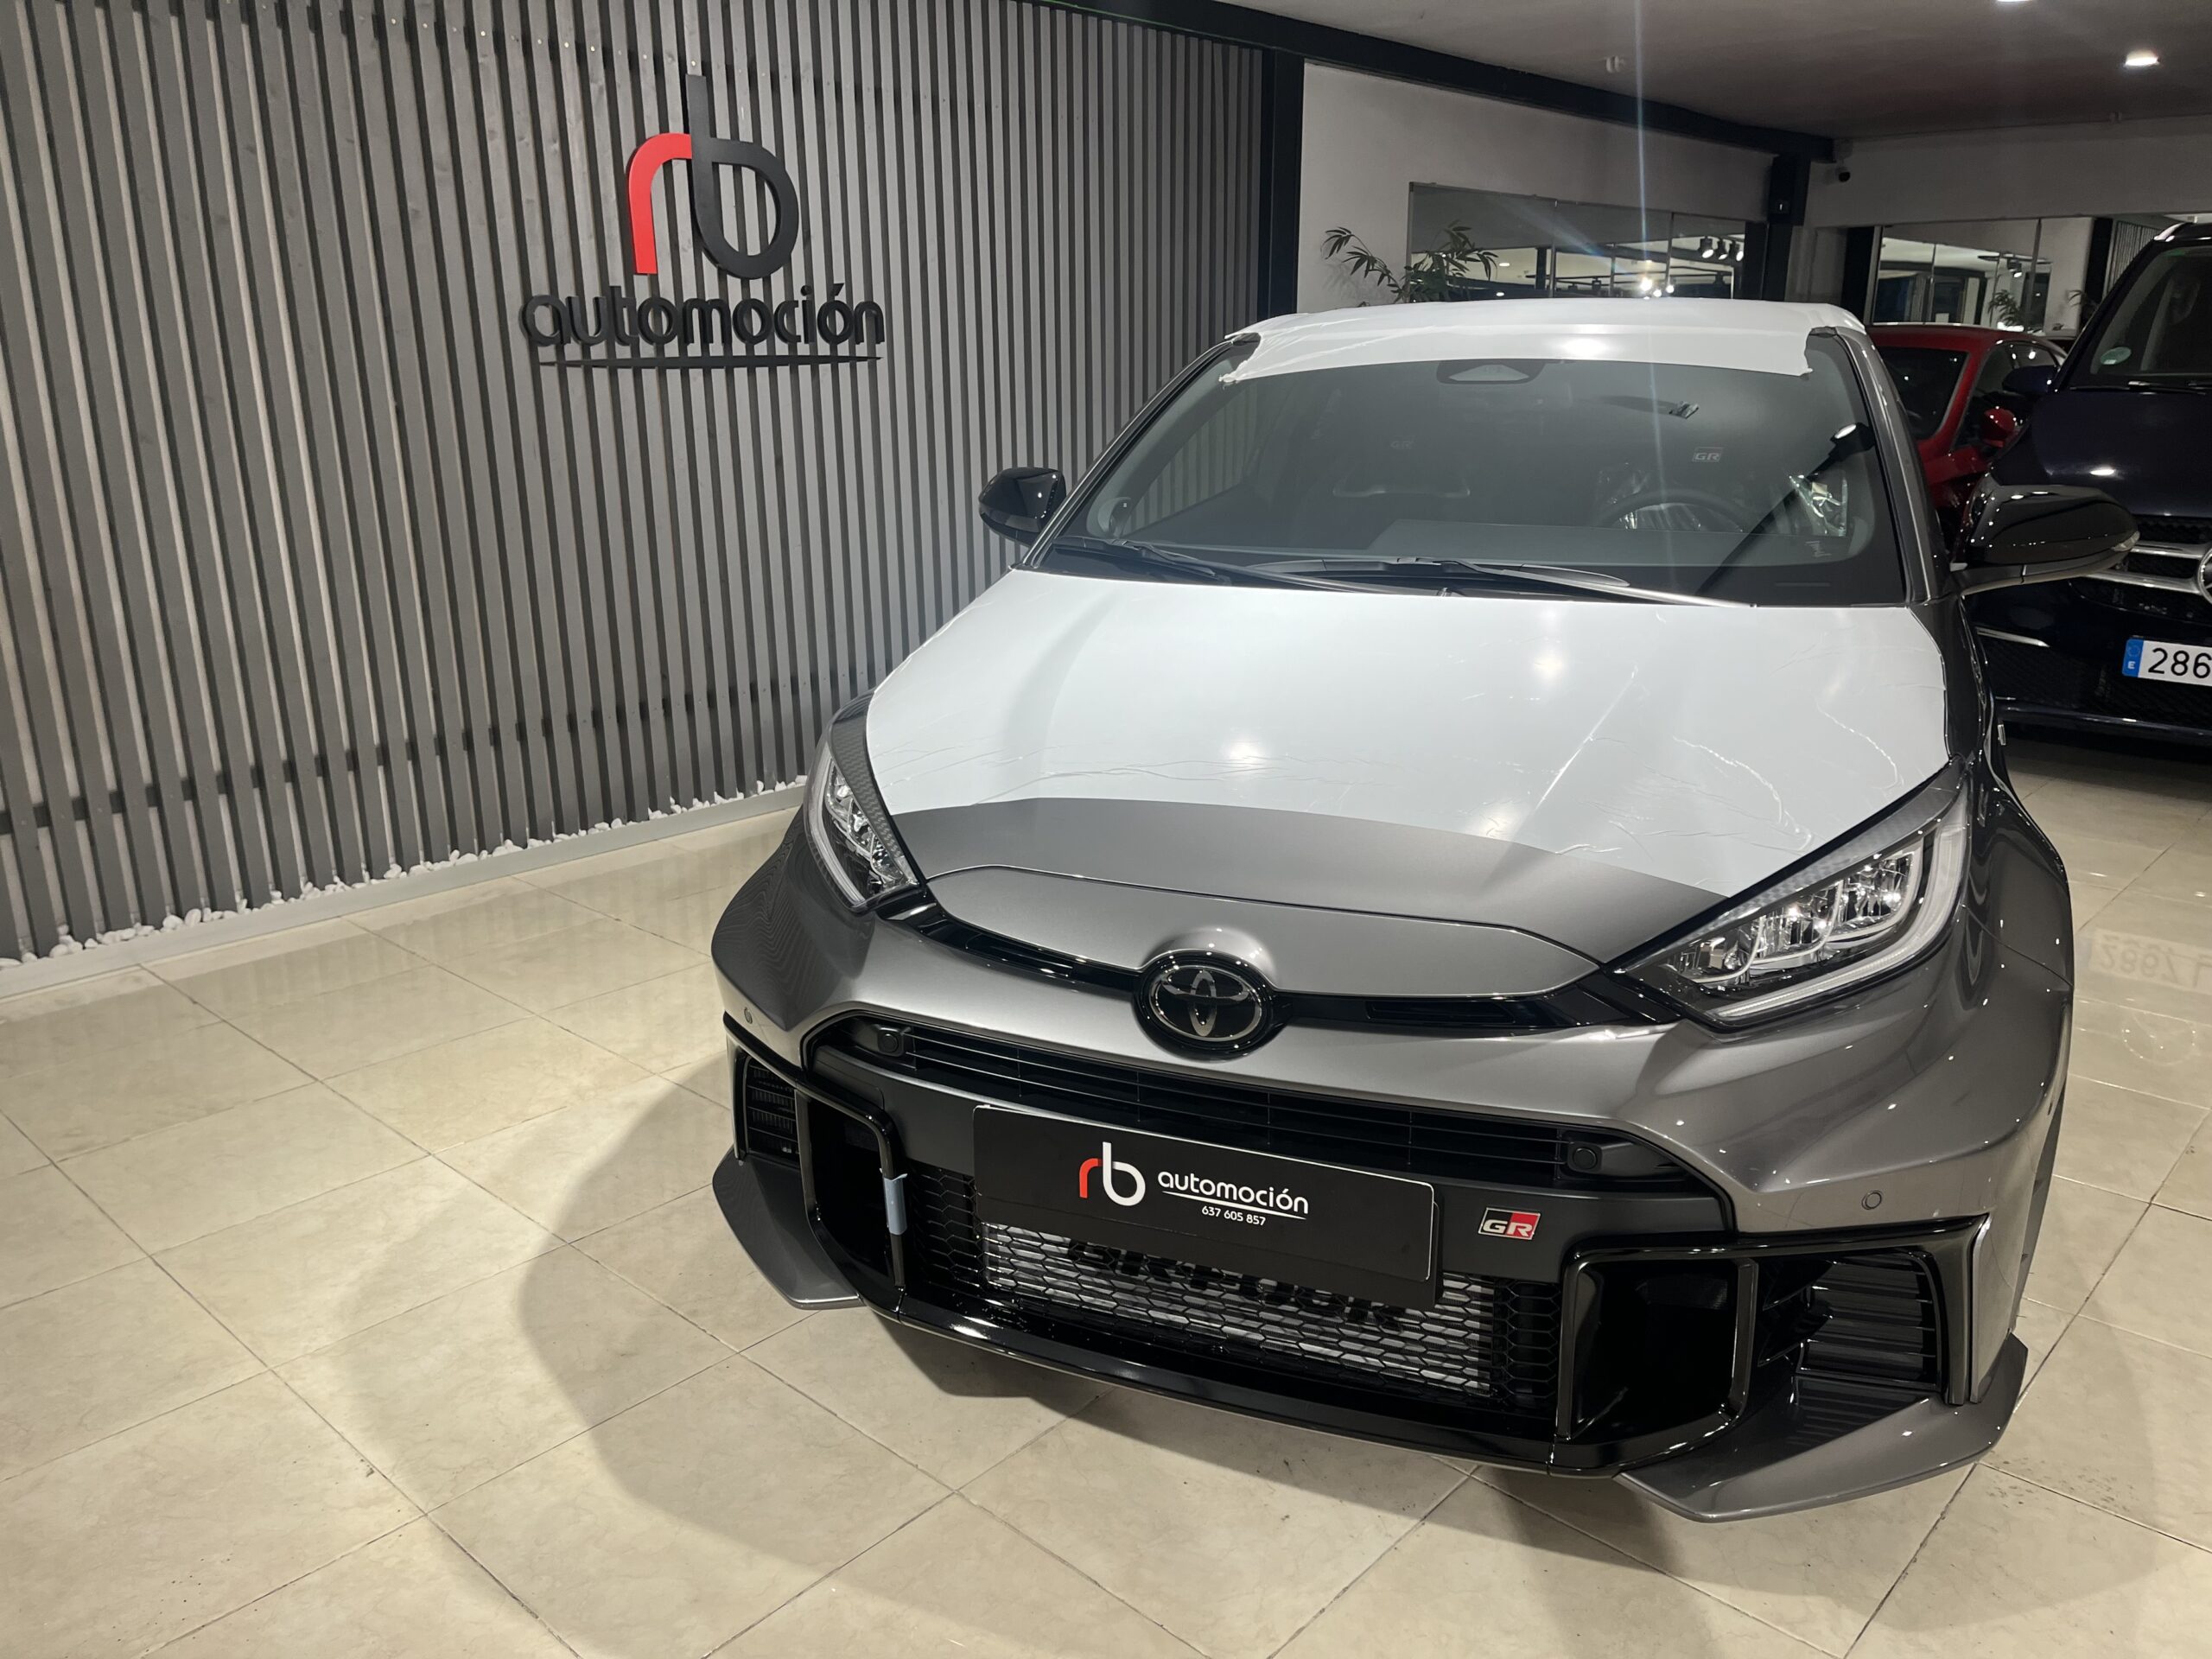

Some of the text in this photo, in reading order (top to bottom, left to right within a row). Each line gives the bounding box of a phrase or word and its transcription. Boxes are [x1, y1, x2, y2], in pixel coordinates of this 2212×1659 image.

[626, 73, 799, 280] rb
[520, 283, 885, 346] automoción
[1694, 452, 1720, 462] GR
[2148, 647, 2212, 678] 286
[1079, 1141, 1146, 1206] rb
[1157, 1171, 1309, 1214] automoción
[1201, 1205, 1266, 1226] 637 605 857
[1483, 1219, 1533, 1237] GR
